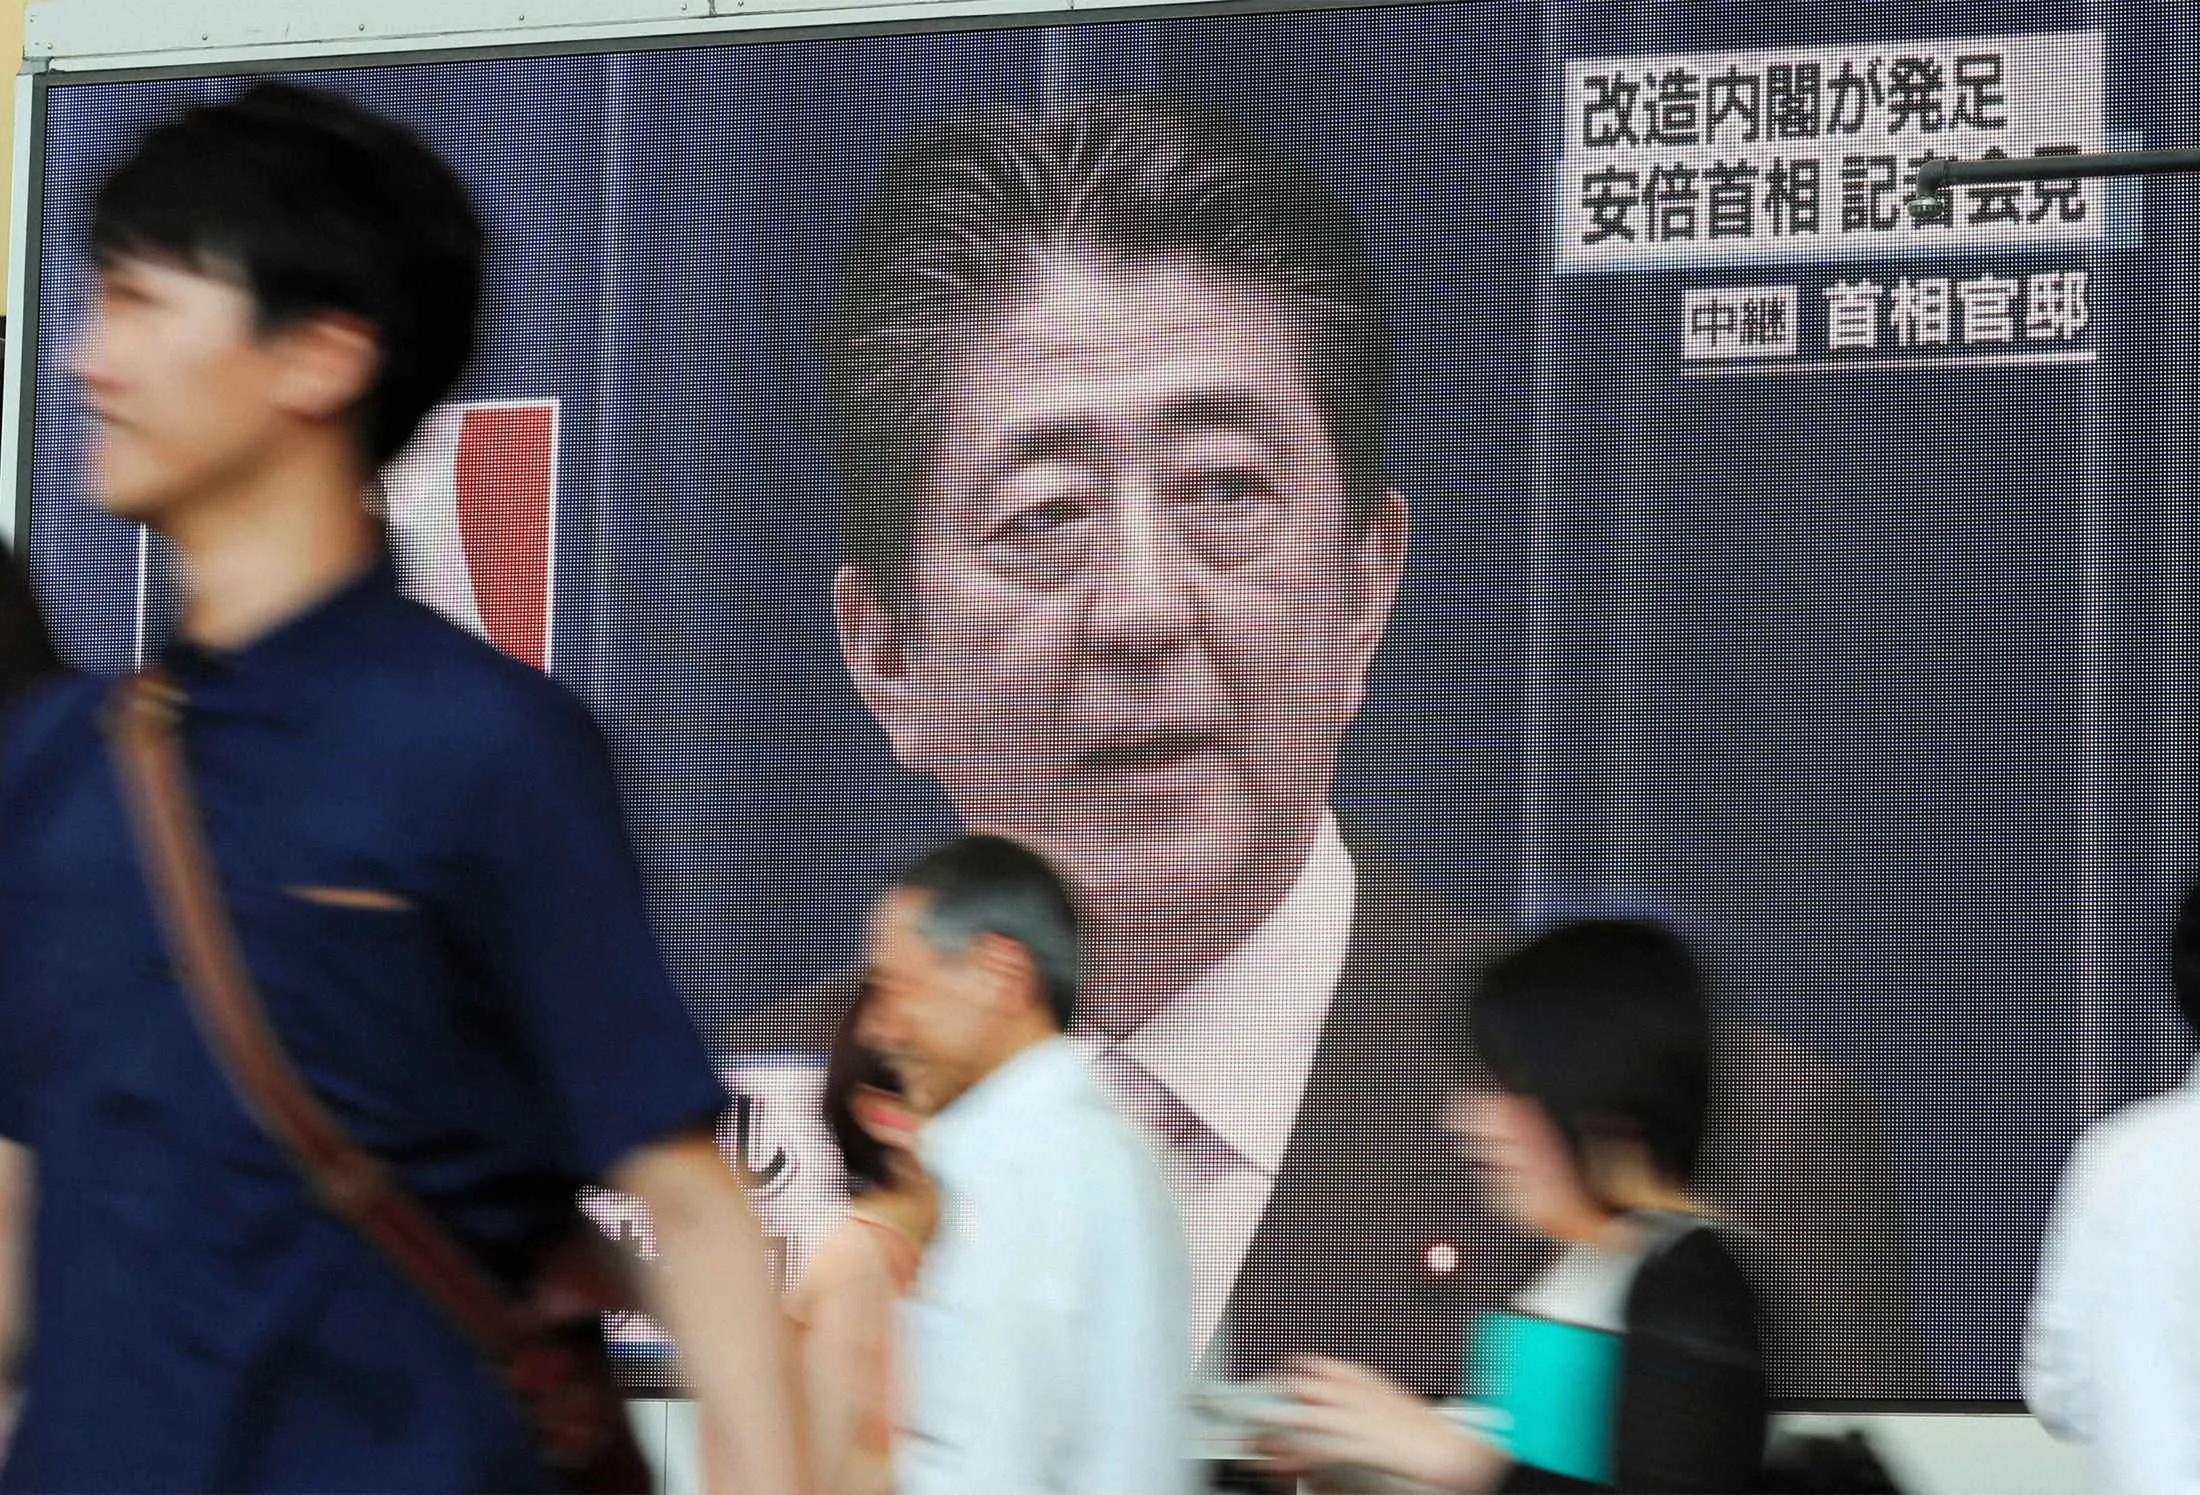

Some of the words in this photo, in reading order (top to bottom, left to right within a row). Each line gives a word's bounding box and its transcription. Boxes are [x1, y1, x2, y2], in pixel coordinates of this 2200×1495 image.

[1582, 53, 2008, 149] 改造内閣が発足
[1581, 156, 1821, 245] 安倍首相
[1690, 299, 1786, 347] 中継
[1824, 269, 2090, 351] 首相官邸
